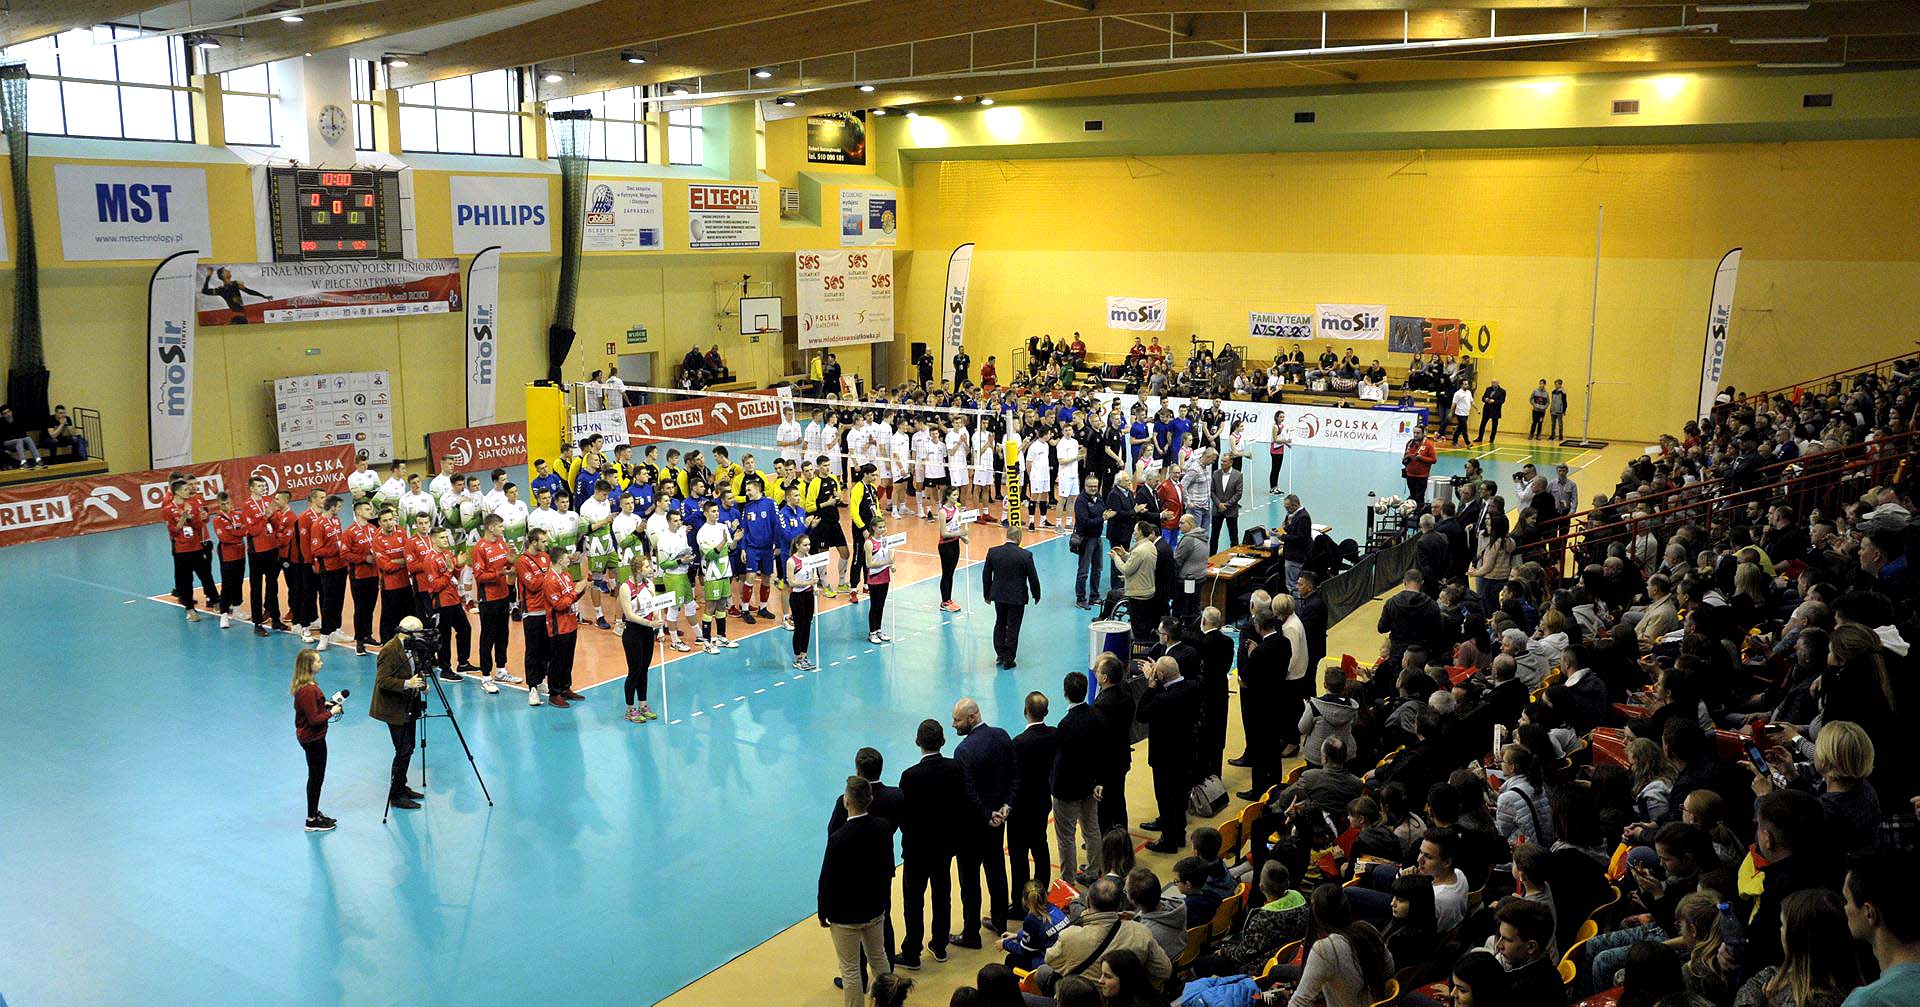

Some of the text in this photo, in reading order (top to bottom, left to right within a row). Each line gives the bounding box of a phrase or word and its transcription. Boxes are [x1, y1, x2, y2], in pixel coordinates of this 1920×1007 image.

[322, 173, 352, 187] 10:00
[95, 183, 172, 223] MST
[690, 187, 750, 210] ELTECH
[457, 204, 546, 226] PHILIPS
[95, 234, 183, 243] www.mstechnology.pl
[362, 261, 397, 273] POLSKI
[311, 280, 321, 289] W
[815, 314, 840, 322] POLSKA
[950, 287, 963, 346] moSir
[1111, 306, 1161, 323] moSir
[1251, 314, 1311, 325] FAMILY TEAM
[1321, 312, 1380, 332] moSir
[473, 304, 493, 385] moSir
[1395, 320, 1491, 354] METRO
[1711, 304, 1729, 383] moSir
[158, 320, 186, 416] moSir
[740, 400, 776, 417] ORLEN
[1224, 410, 1259, 424] ajska
[663, 411, 700, 428] ORLEN
[1325, 418, 1379, 431] POLSKA
[476, 433, 525, 448] POLSKA
[1324, 430, 1379, 441] SIATKÓWKA
[478, 445, 527, 460] SIATKÓWKA
[284, 459, 344, 477] POLSKA
[287, 472, 347, 489] SIATKÓWKA
[0, 500, 65, 526] RLEN
